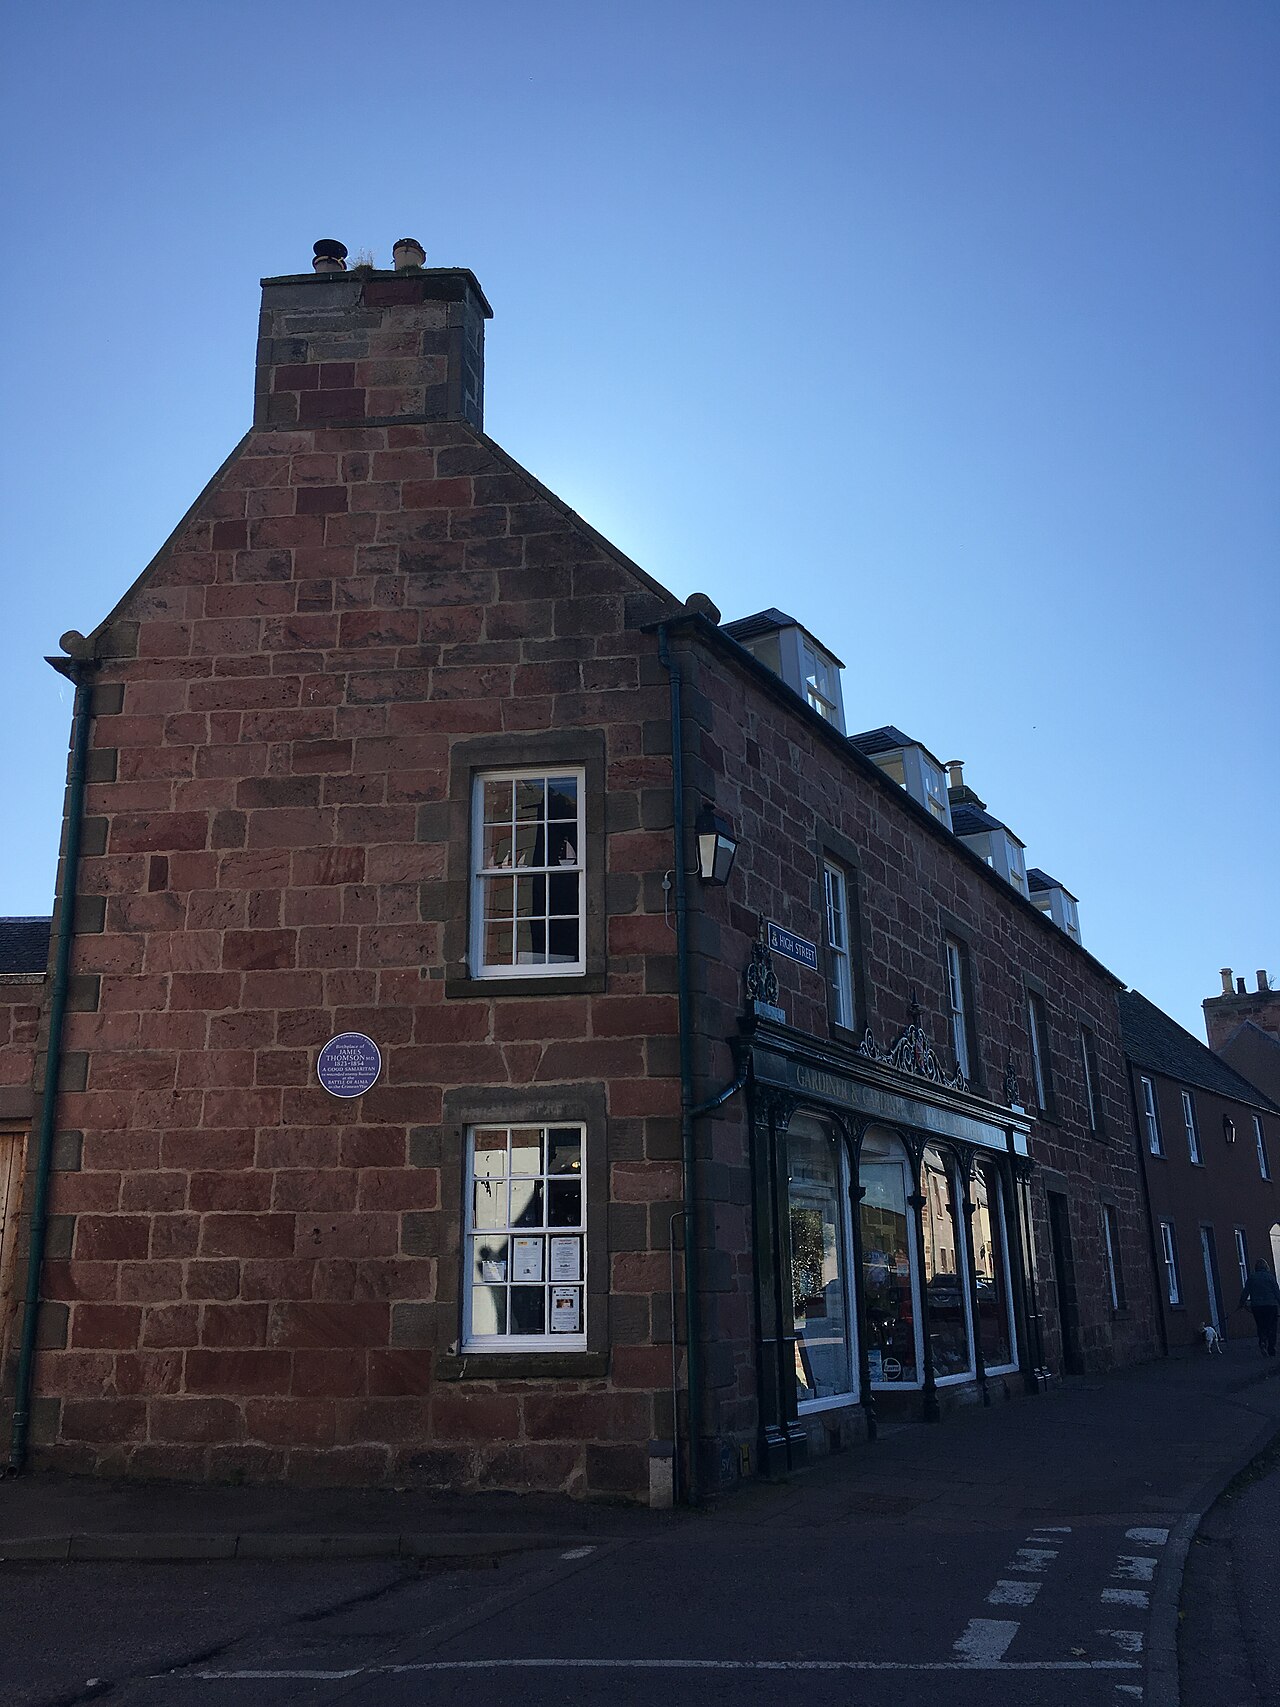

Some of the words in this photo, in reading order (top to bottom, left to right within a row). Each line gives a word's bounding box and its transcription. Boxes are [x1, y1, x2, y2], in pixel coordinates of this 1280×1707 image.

[779, 935, 794, 952] HIGH
[795, 943, 815, 961] STREET
[326, 1054, 365, 1062] THOMSON
[796, 1065, 849, 1100] GARDINER
[851, 1083, 860, 1104] &
